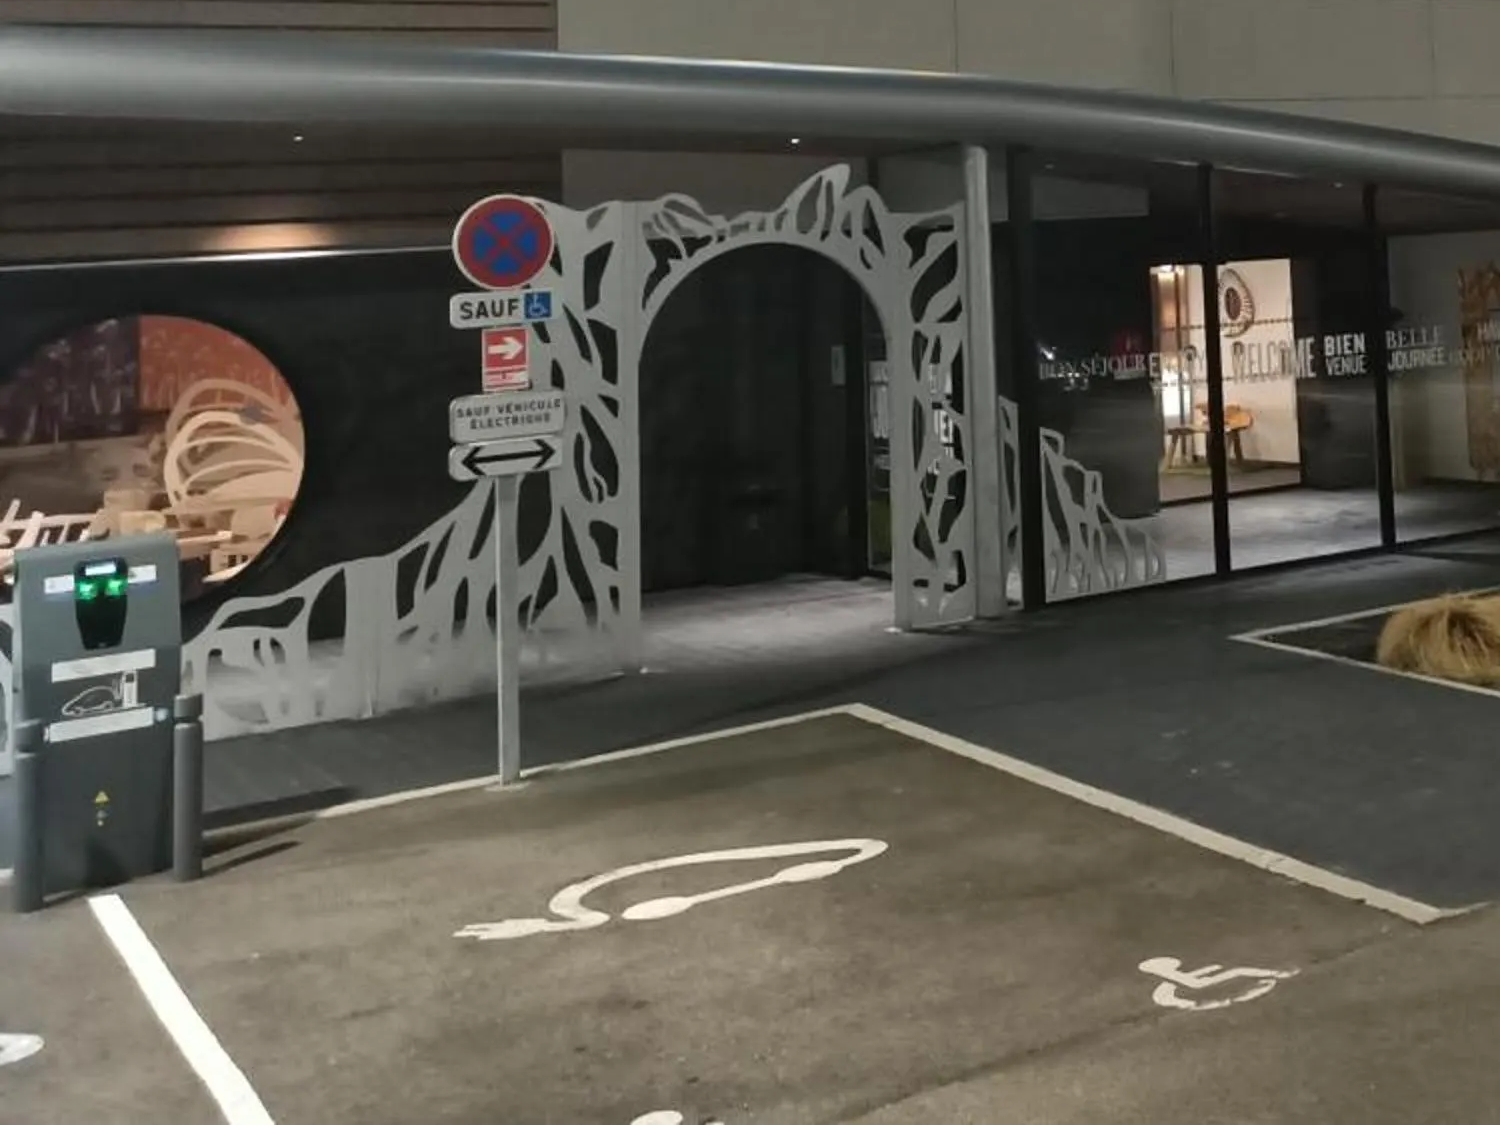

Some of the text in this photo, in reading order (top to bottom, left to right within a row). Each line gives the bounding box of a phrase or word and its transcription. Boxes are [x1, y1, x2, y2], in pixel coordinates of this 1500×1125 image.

[460, 298, 519, 320] SAUF
[1323, 333, 1366, 356] BIEN
[1231, 335, 1317, 383] WELCOME
[1325, 355, 1368, 376] VENUE
[456, 404, 491, 419] SAUF
